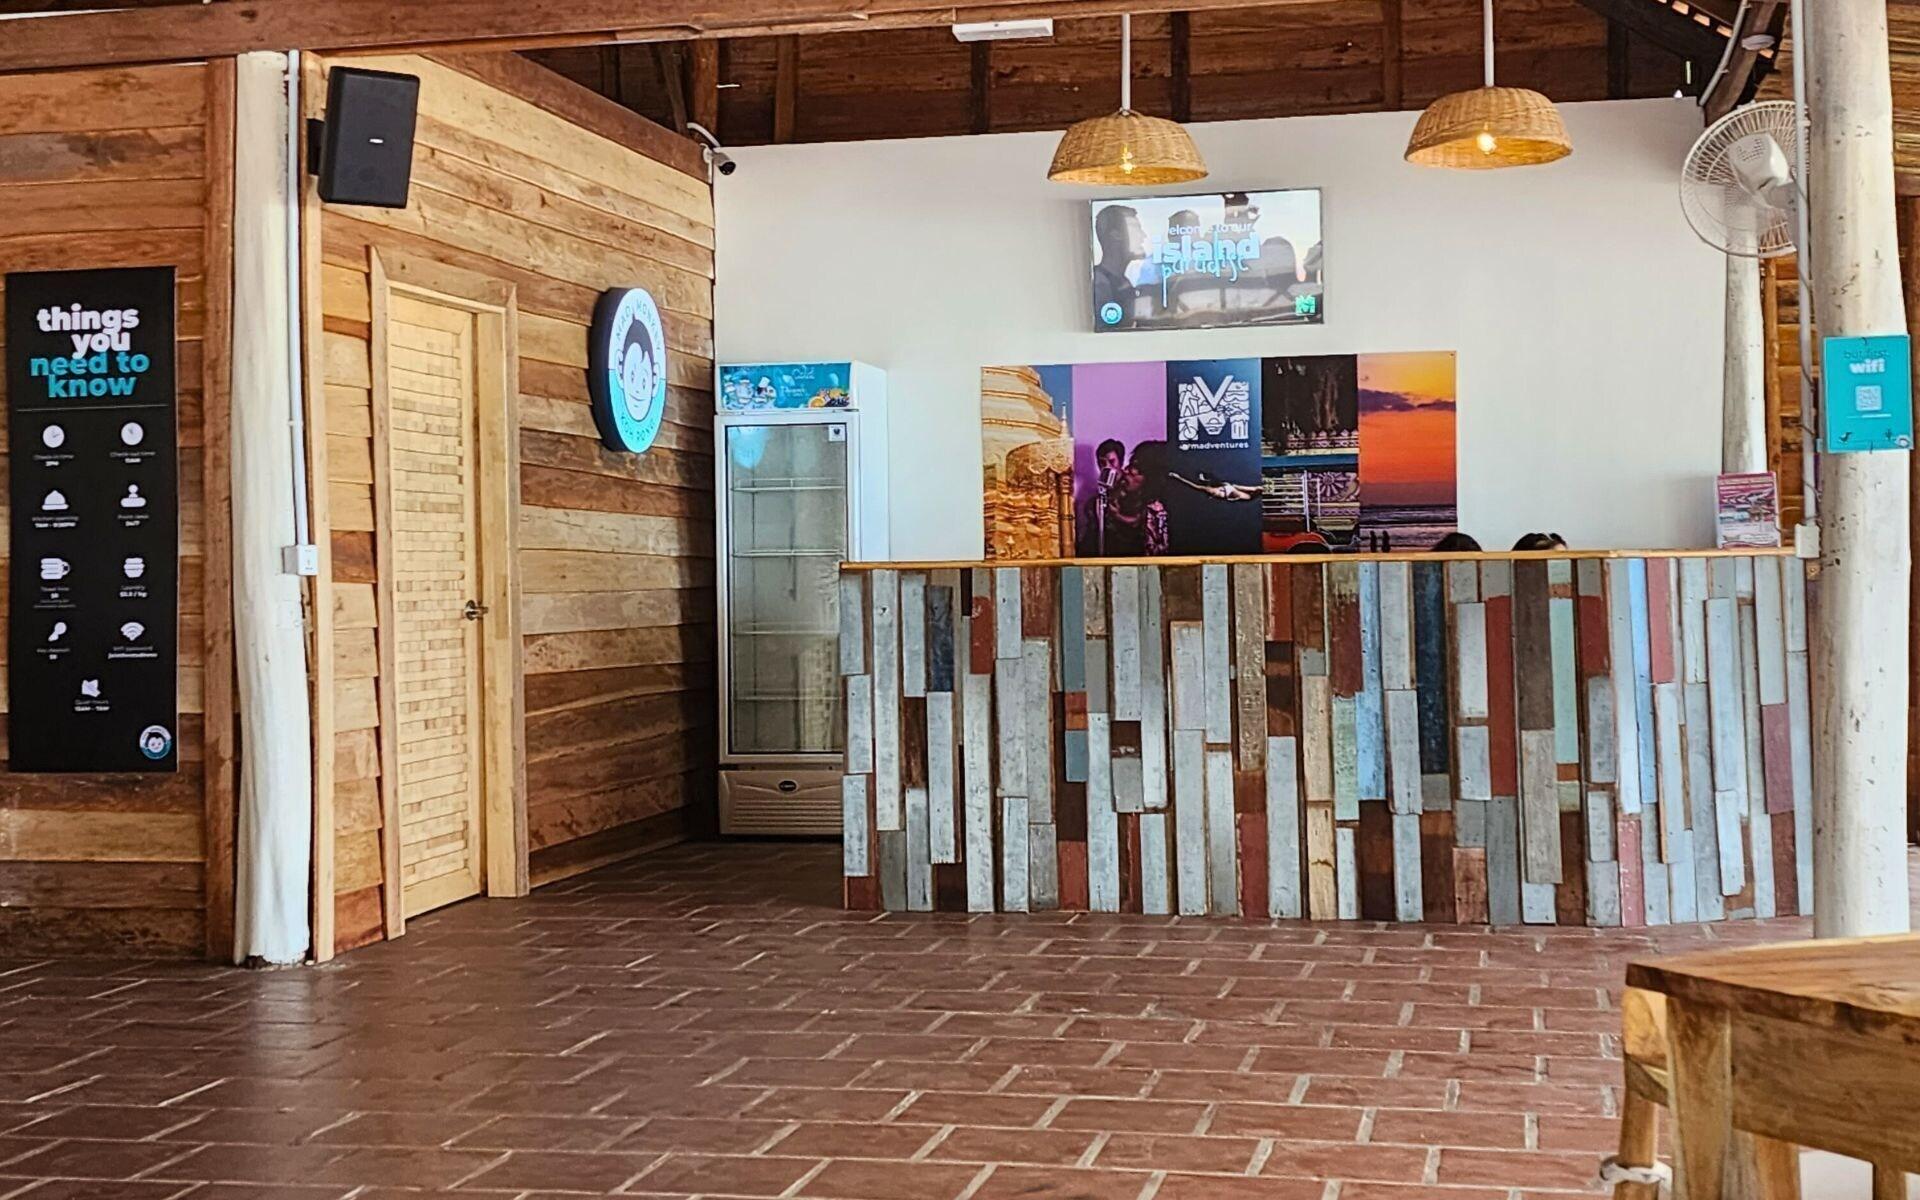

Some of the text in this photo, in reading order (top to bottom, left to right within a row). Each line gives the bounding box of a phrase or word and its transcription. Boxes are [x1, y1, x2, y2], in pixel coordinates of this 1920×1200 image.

[1152, 230, 1260, 264] island
[36, 302, 140, 333] things
[71, 331, 131, 359] you
[30, 351, 150, 377] need to
[1848, 358, 1886, 374] wifi
[48, 374, 137, 398] know
